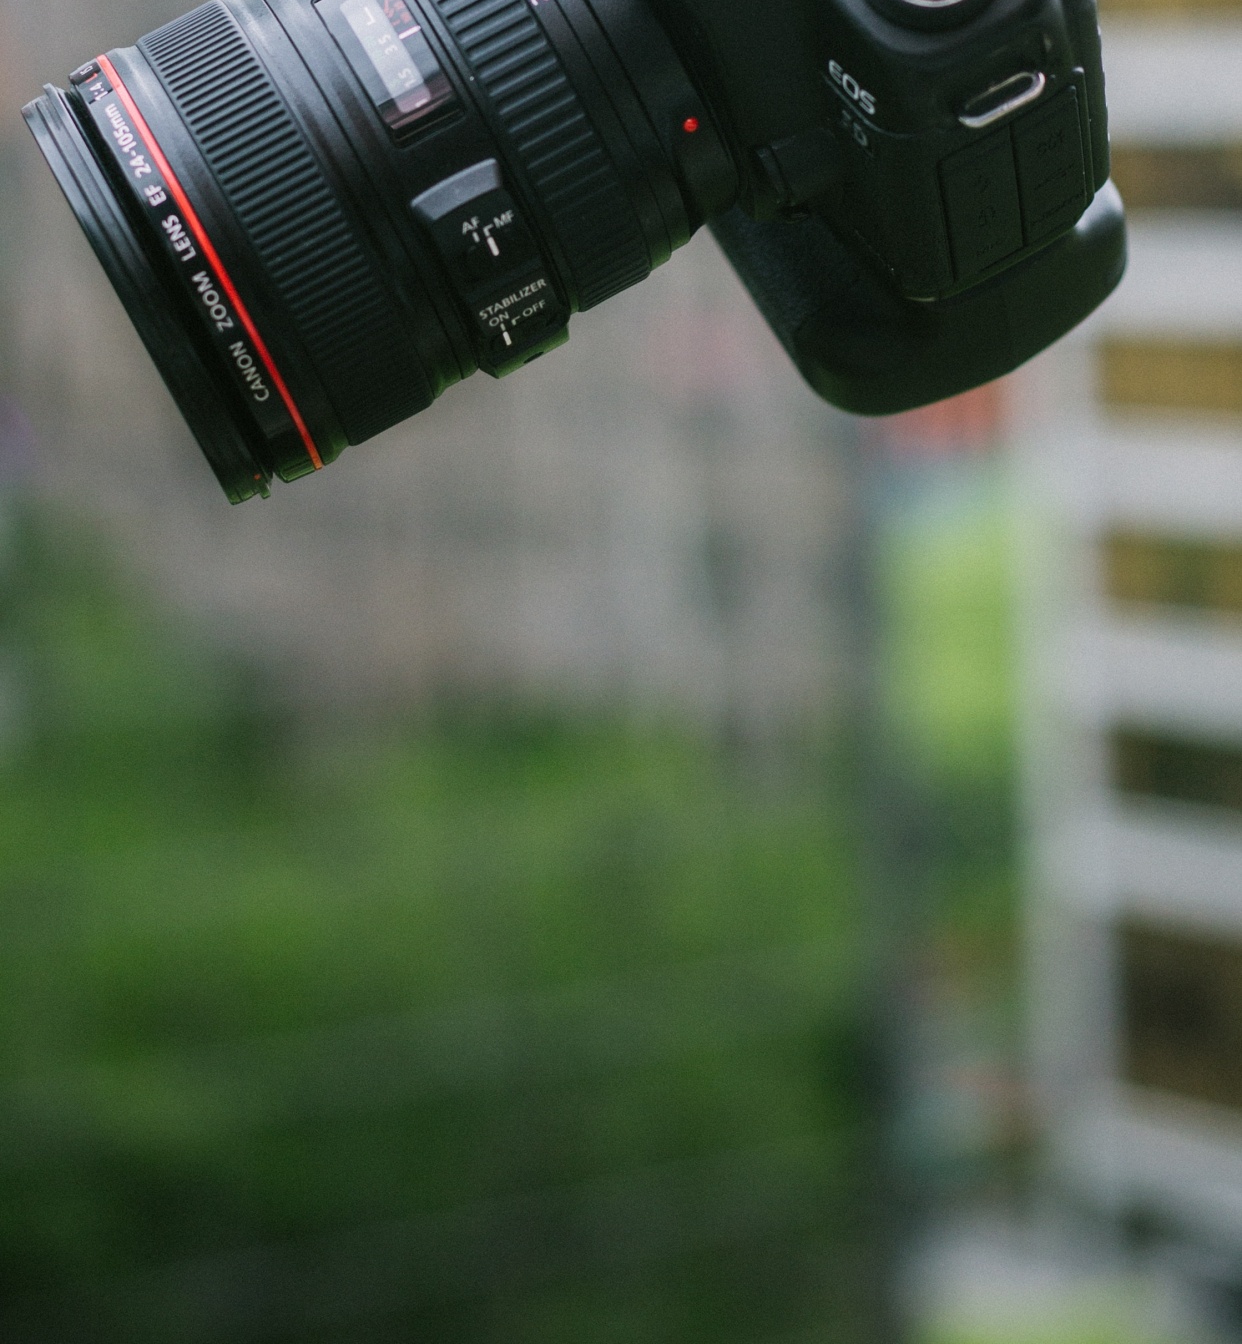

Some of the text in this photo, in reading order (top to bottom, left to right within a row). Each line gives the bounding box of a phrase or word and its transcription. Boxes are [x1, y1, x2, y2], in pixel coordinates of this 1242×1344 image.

[828, 58, 877, 116] EOS
[105, 103, 152, 179] 24-105mm
[144, 184, 168, 207] EF
[161, 214, 197, 262] LENS
[462, 216, 480, 235] AF
[493, 209, 514, 229] MF
[191, 270, 234, 332] ZOOM
[479, 278, 547, 320] STABILIZER
[488, 311, 509, 327] ON
[522, 299, 547, 317] OFF
[229, 340, 269, 401] CANON
